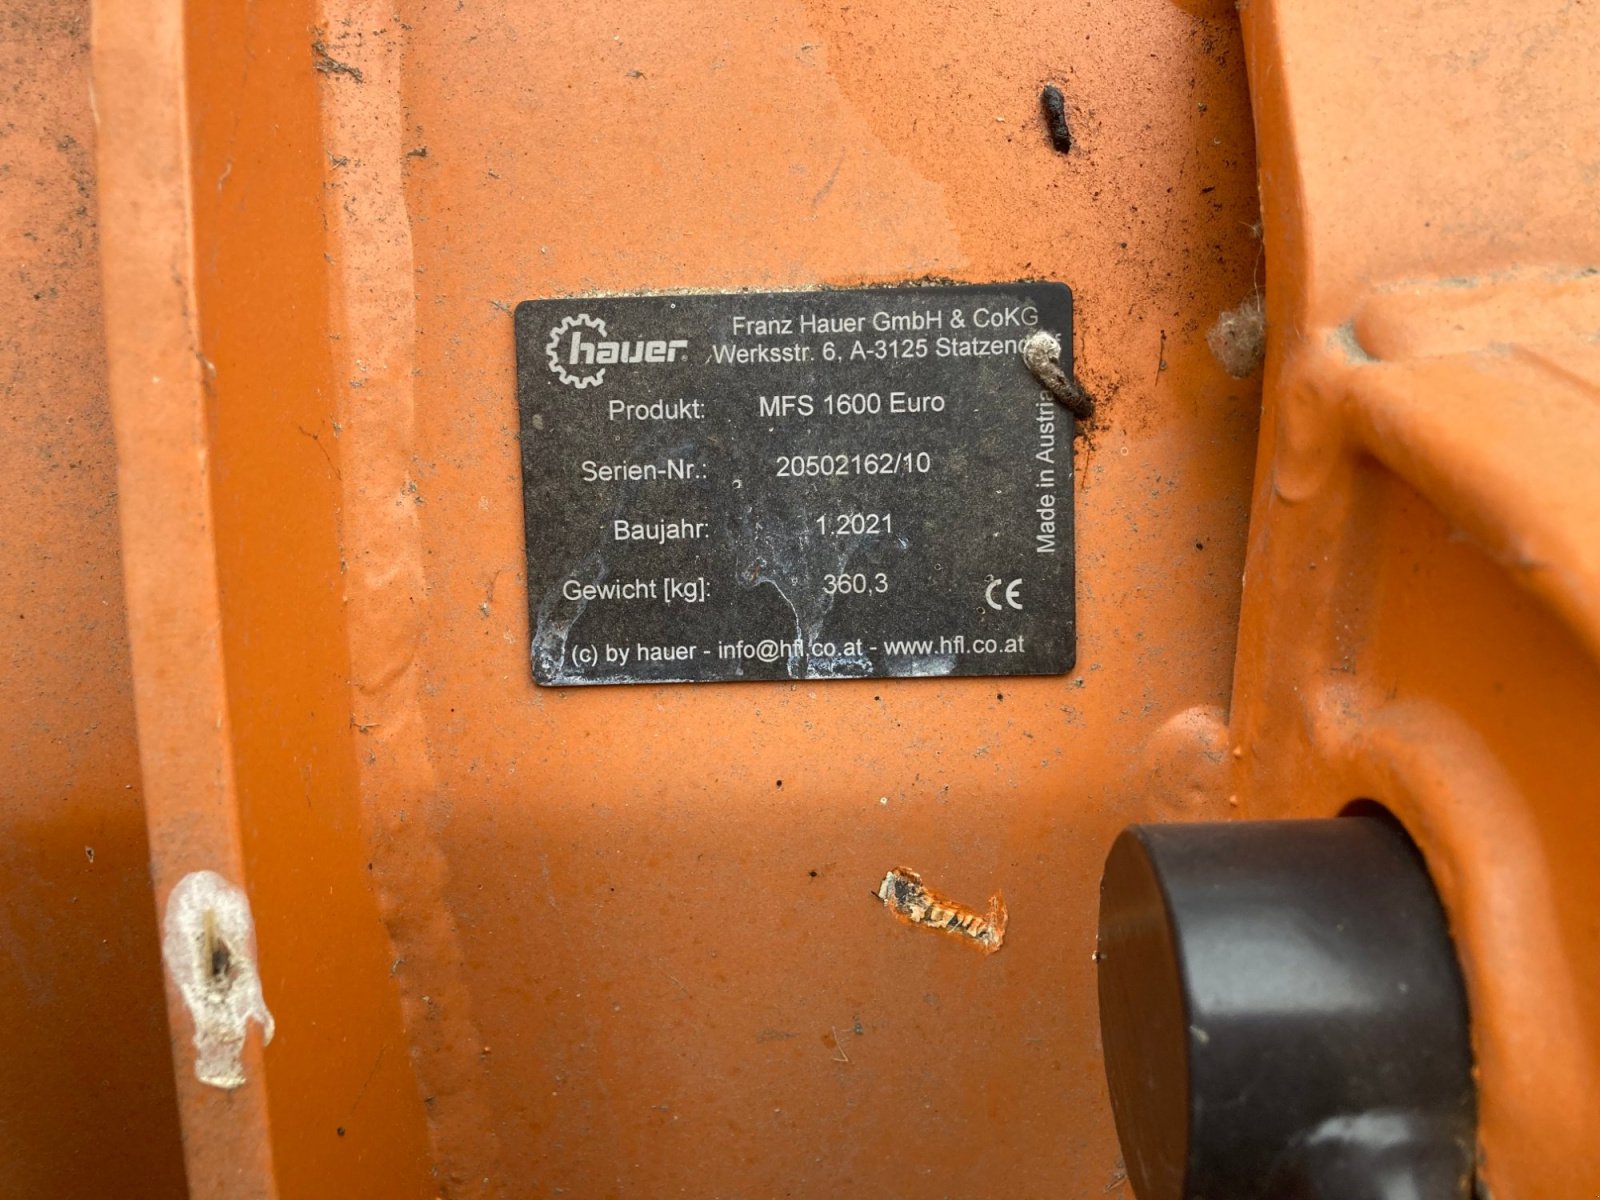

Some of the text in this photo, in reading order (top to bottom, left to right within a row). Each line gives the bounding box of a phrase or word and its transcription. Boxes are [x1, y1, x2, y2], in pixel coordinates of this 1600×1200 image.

[732, 306, 1039, 336] Franz Hauer GmbH & CoKG
[569, 331, 688, 365] hauer
[712, 332, 1062, 365] Werksstr. 6, A-3125 Statzen
[609, 391, 946, 421] Produkt: MFS 1600 Euro
[581, 451, 931, 482] Serien-Nr.: 20502162/10
[1035, 469, 1055, 488] in
[613, 513, 892, 545] Baujahr: 1.2021
[1035, 494, 1056, 553] Made
[562, 572, 889, 603] Gewicht [kg]: 360,3
[985, 577, 1024, 611] CE
[571, 643, 598, 668] (c)
[605, 642, 630, 666] by
[637, 642, 697, 662] hauer
[718, 637, 863, 663] info@hfl.co.at
[883, 634, 1026, 656] www.hfl.co.at
